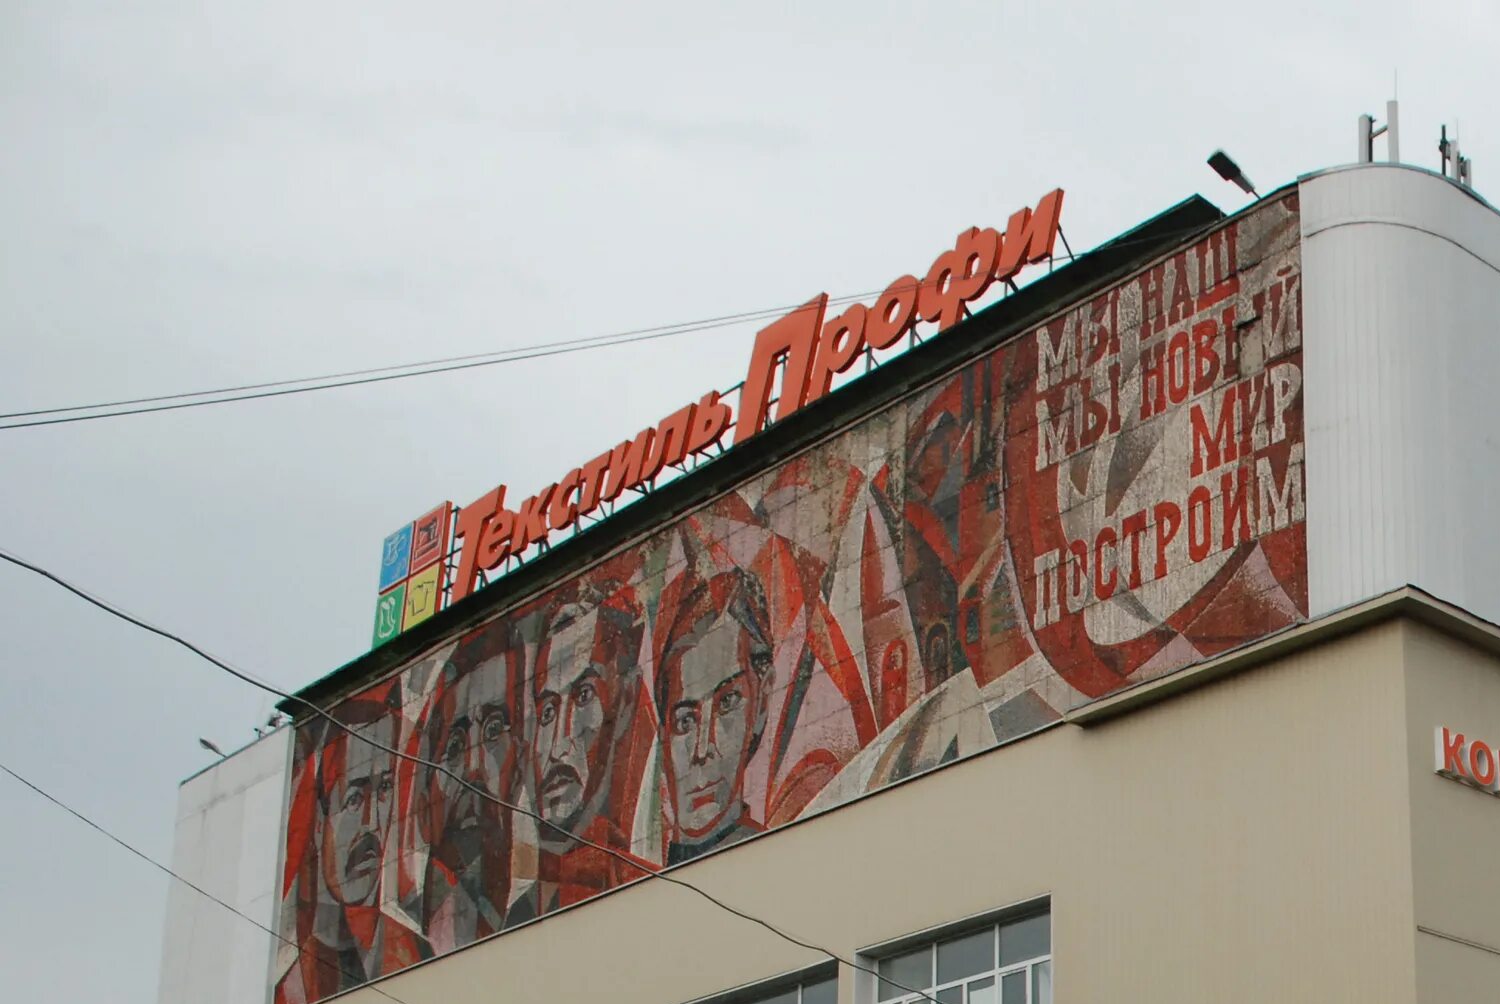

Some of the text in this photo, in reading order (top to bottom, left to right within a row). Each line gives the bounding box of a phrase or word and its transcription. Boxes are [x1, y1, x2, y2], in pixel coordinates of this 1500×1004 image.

[1036, 222, 1240, 393] МЫ НАШ
[1036, 365, 1121, 471] МЫ
[1190, 363, 1302, 478] МИР
[1034, 441, 1305, 631] ПОСТРОИМ
